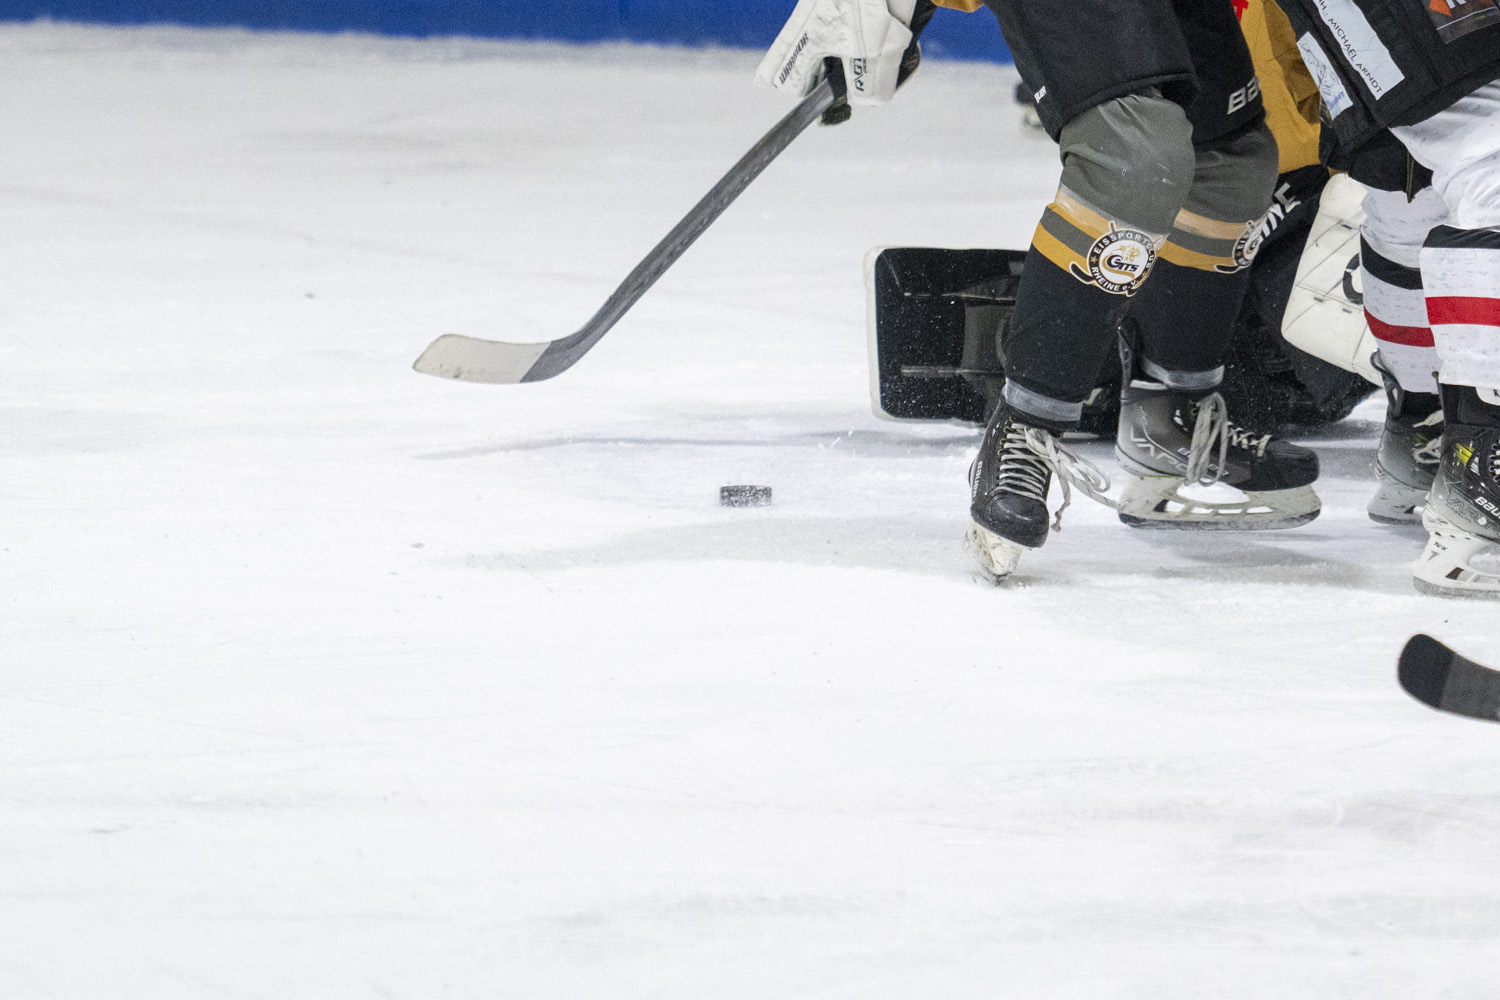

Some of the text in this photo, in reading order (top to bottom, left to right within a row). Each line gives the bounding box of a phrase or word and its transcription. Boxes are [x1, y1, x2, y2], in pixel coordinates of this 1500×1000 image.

[779, 32, 809, 86] WARRIOR
[1328, 18, 1358, 63] MICHAEL
[1355, 61, 1384, 95] ARNDT
[1091, 266, 1121, 292] RHEINE
